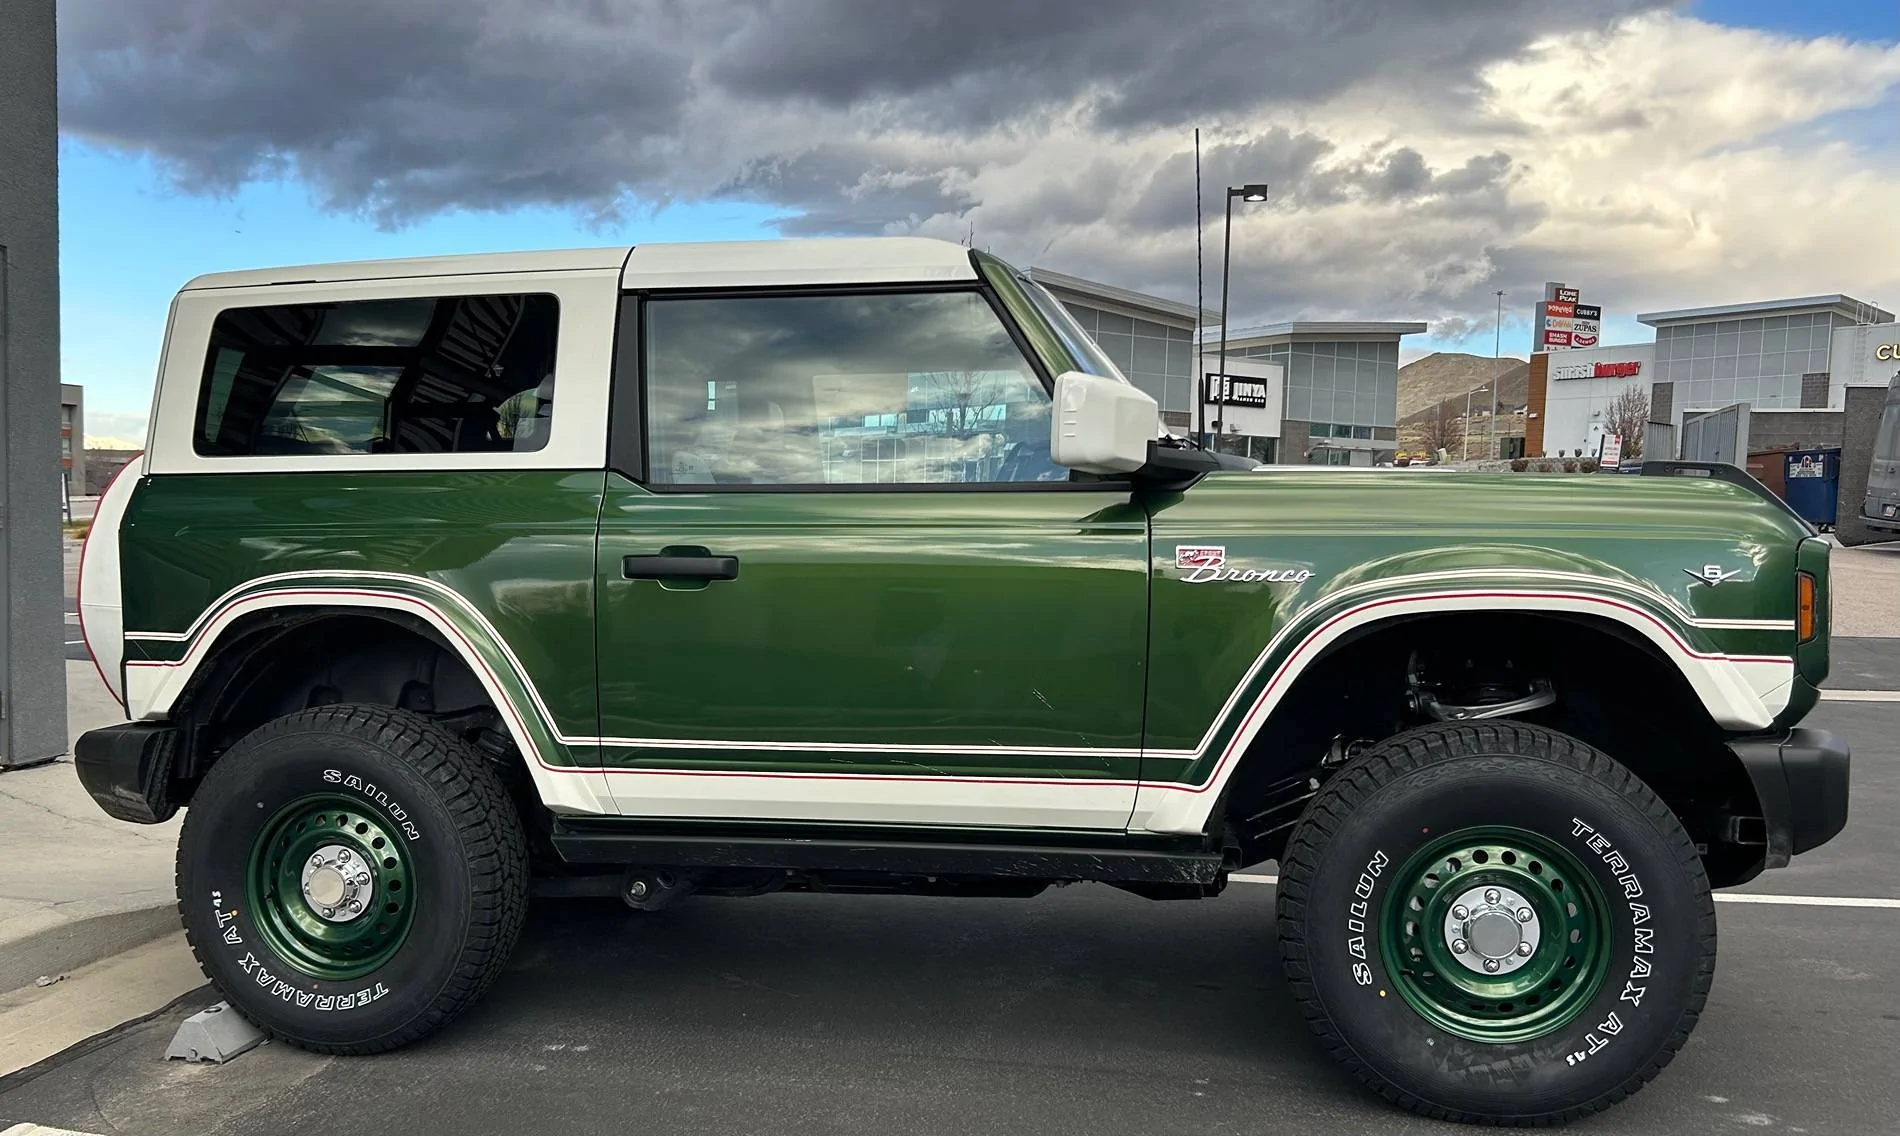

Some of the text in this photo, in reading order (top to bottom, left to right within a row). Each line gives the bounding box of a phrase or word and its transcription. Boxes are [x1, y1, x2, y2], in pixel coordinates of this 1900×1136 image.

[1548, 305, 1572, 314] POPEYES
[1574, 323, 1597, 332] ZUPAS
[1553, 361, 1641, 380] smashburger
[1232, 382, 1266, 400] JINYA
[1180, 556, 1316, 583] Bronco
[323, 769, 420, 841] SAILUN
[1348, 850, 1390, 987] SAILUN
[1570, 817, 1654, 1008] TERRAMAX
[237, 951, 390, 1011] TERRAMAX
